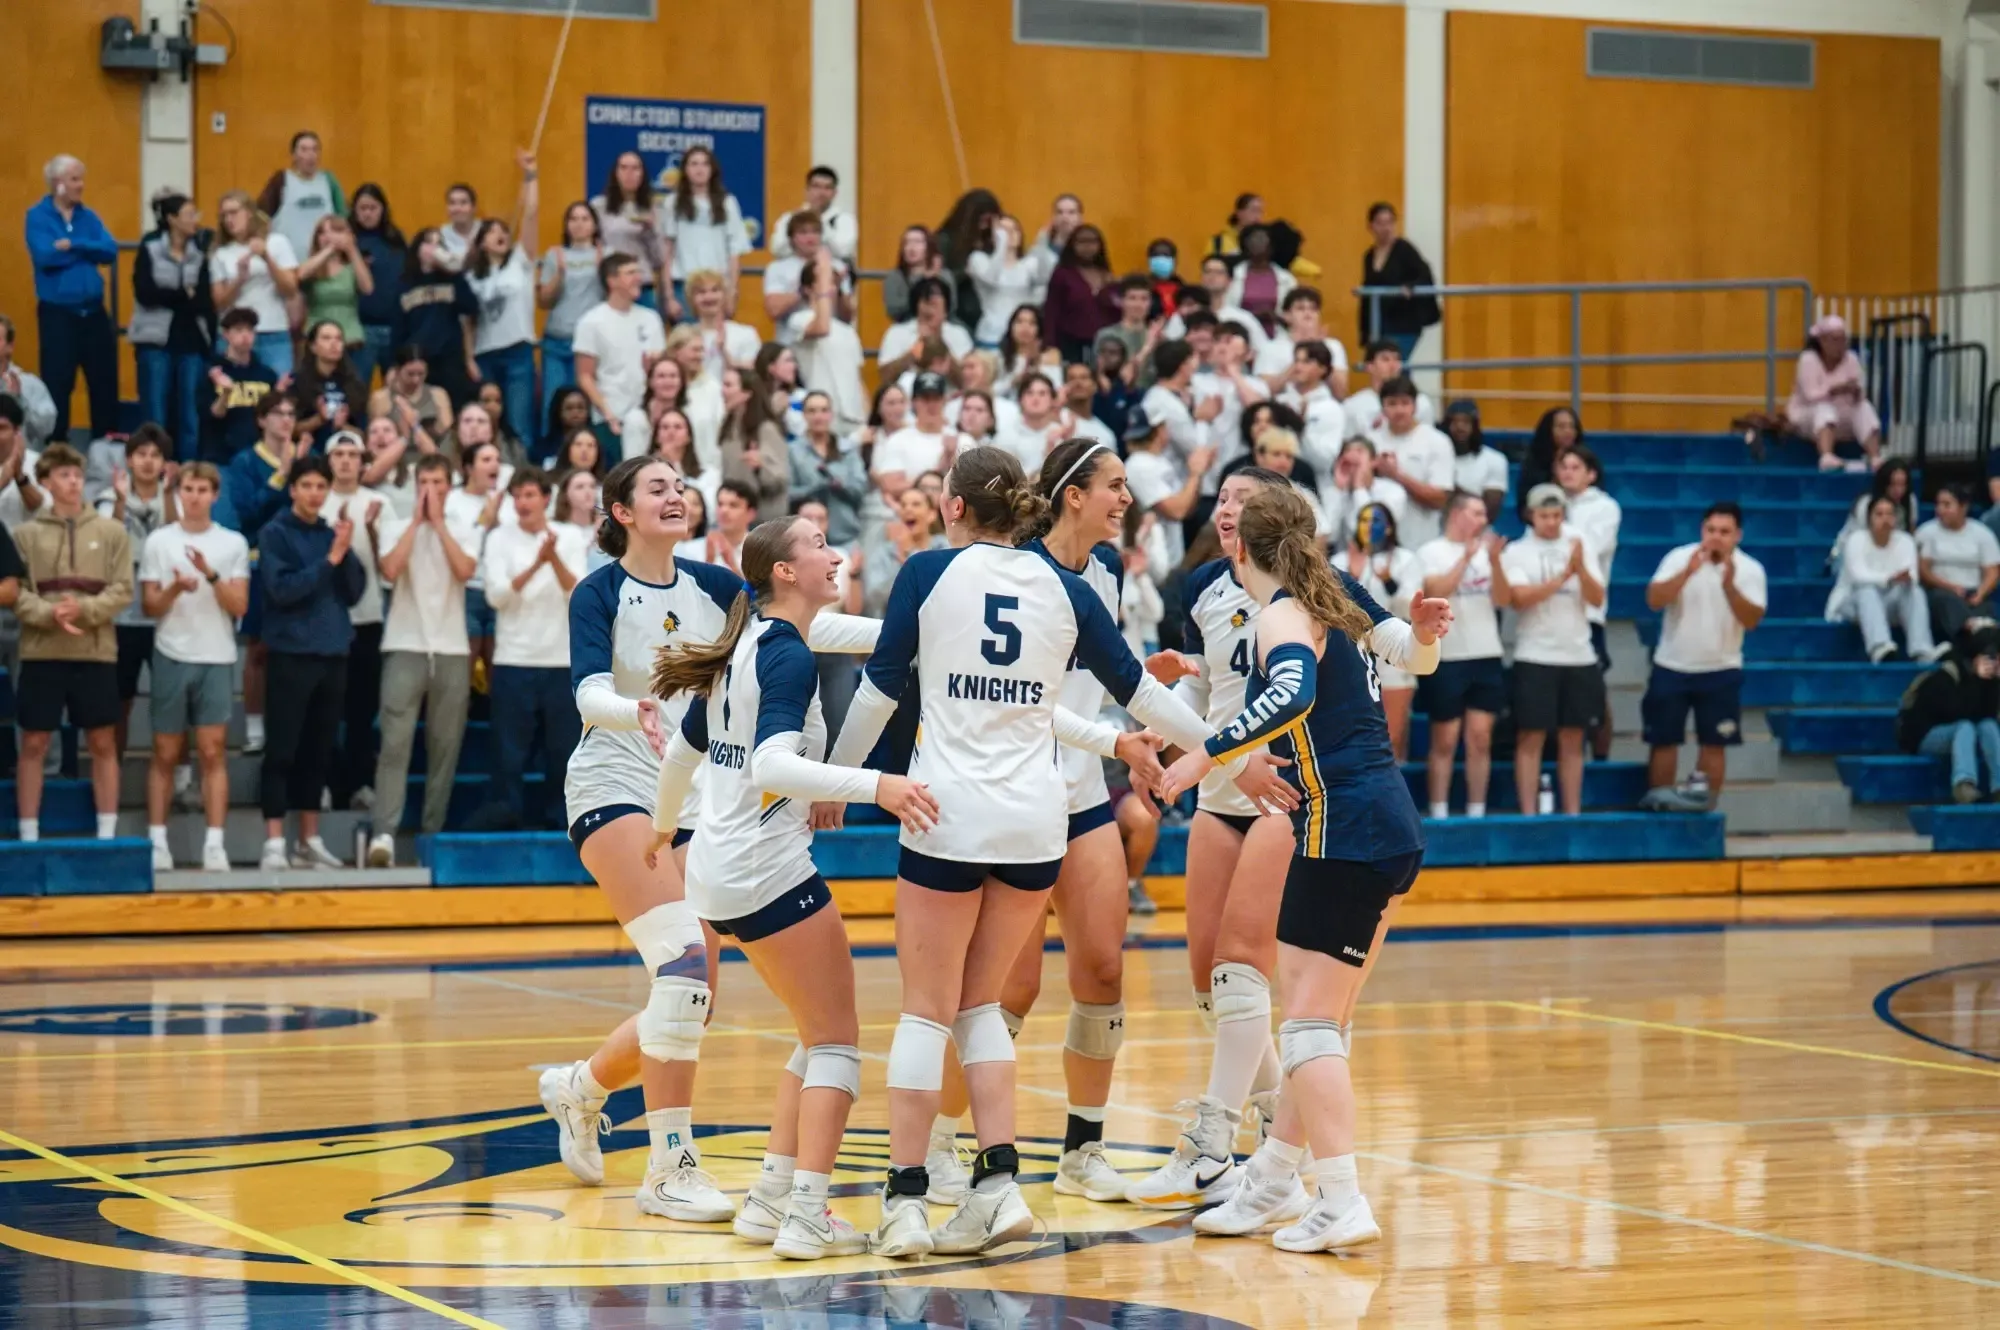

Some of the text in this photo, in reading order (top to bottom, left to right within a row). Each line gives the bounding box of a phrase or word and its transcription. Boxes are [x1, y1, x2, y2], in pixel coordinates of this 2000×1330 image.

[589, 104, 761, 131] CARLETON STUDENT
[980, 592, 1022, 667] 5
[1229, 638, 1251, 677] 4
[948, 673, 1044, 704] KNIGHTS
[708, 739, 746, 770] NIGHTS
